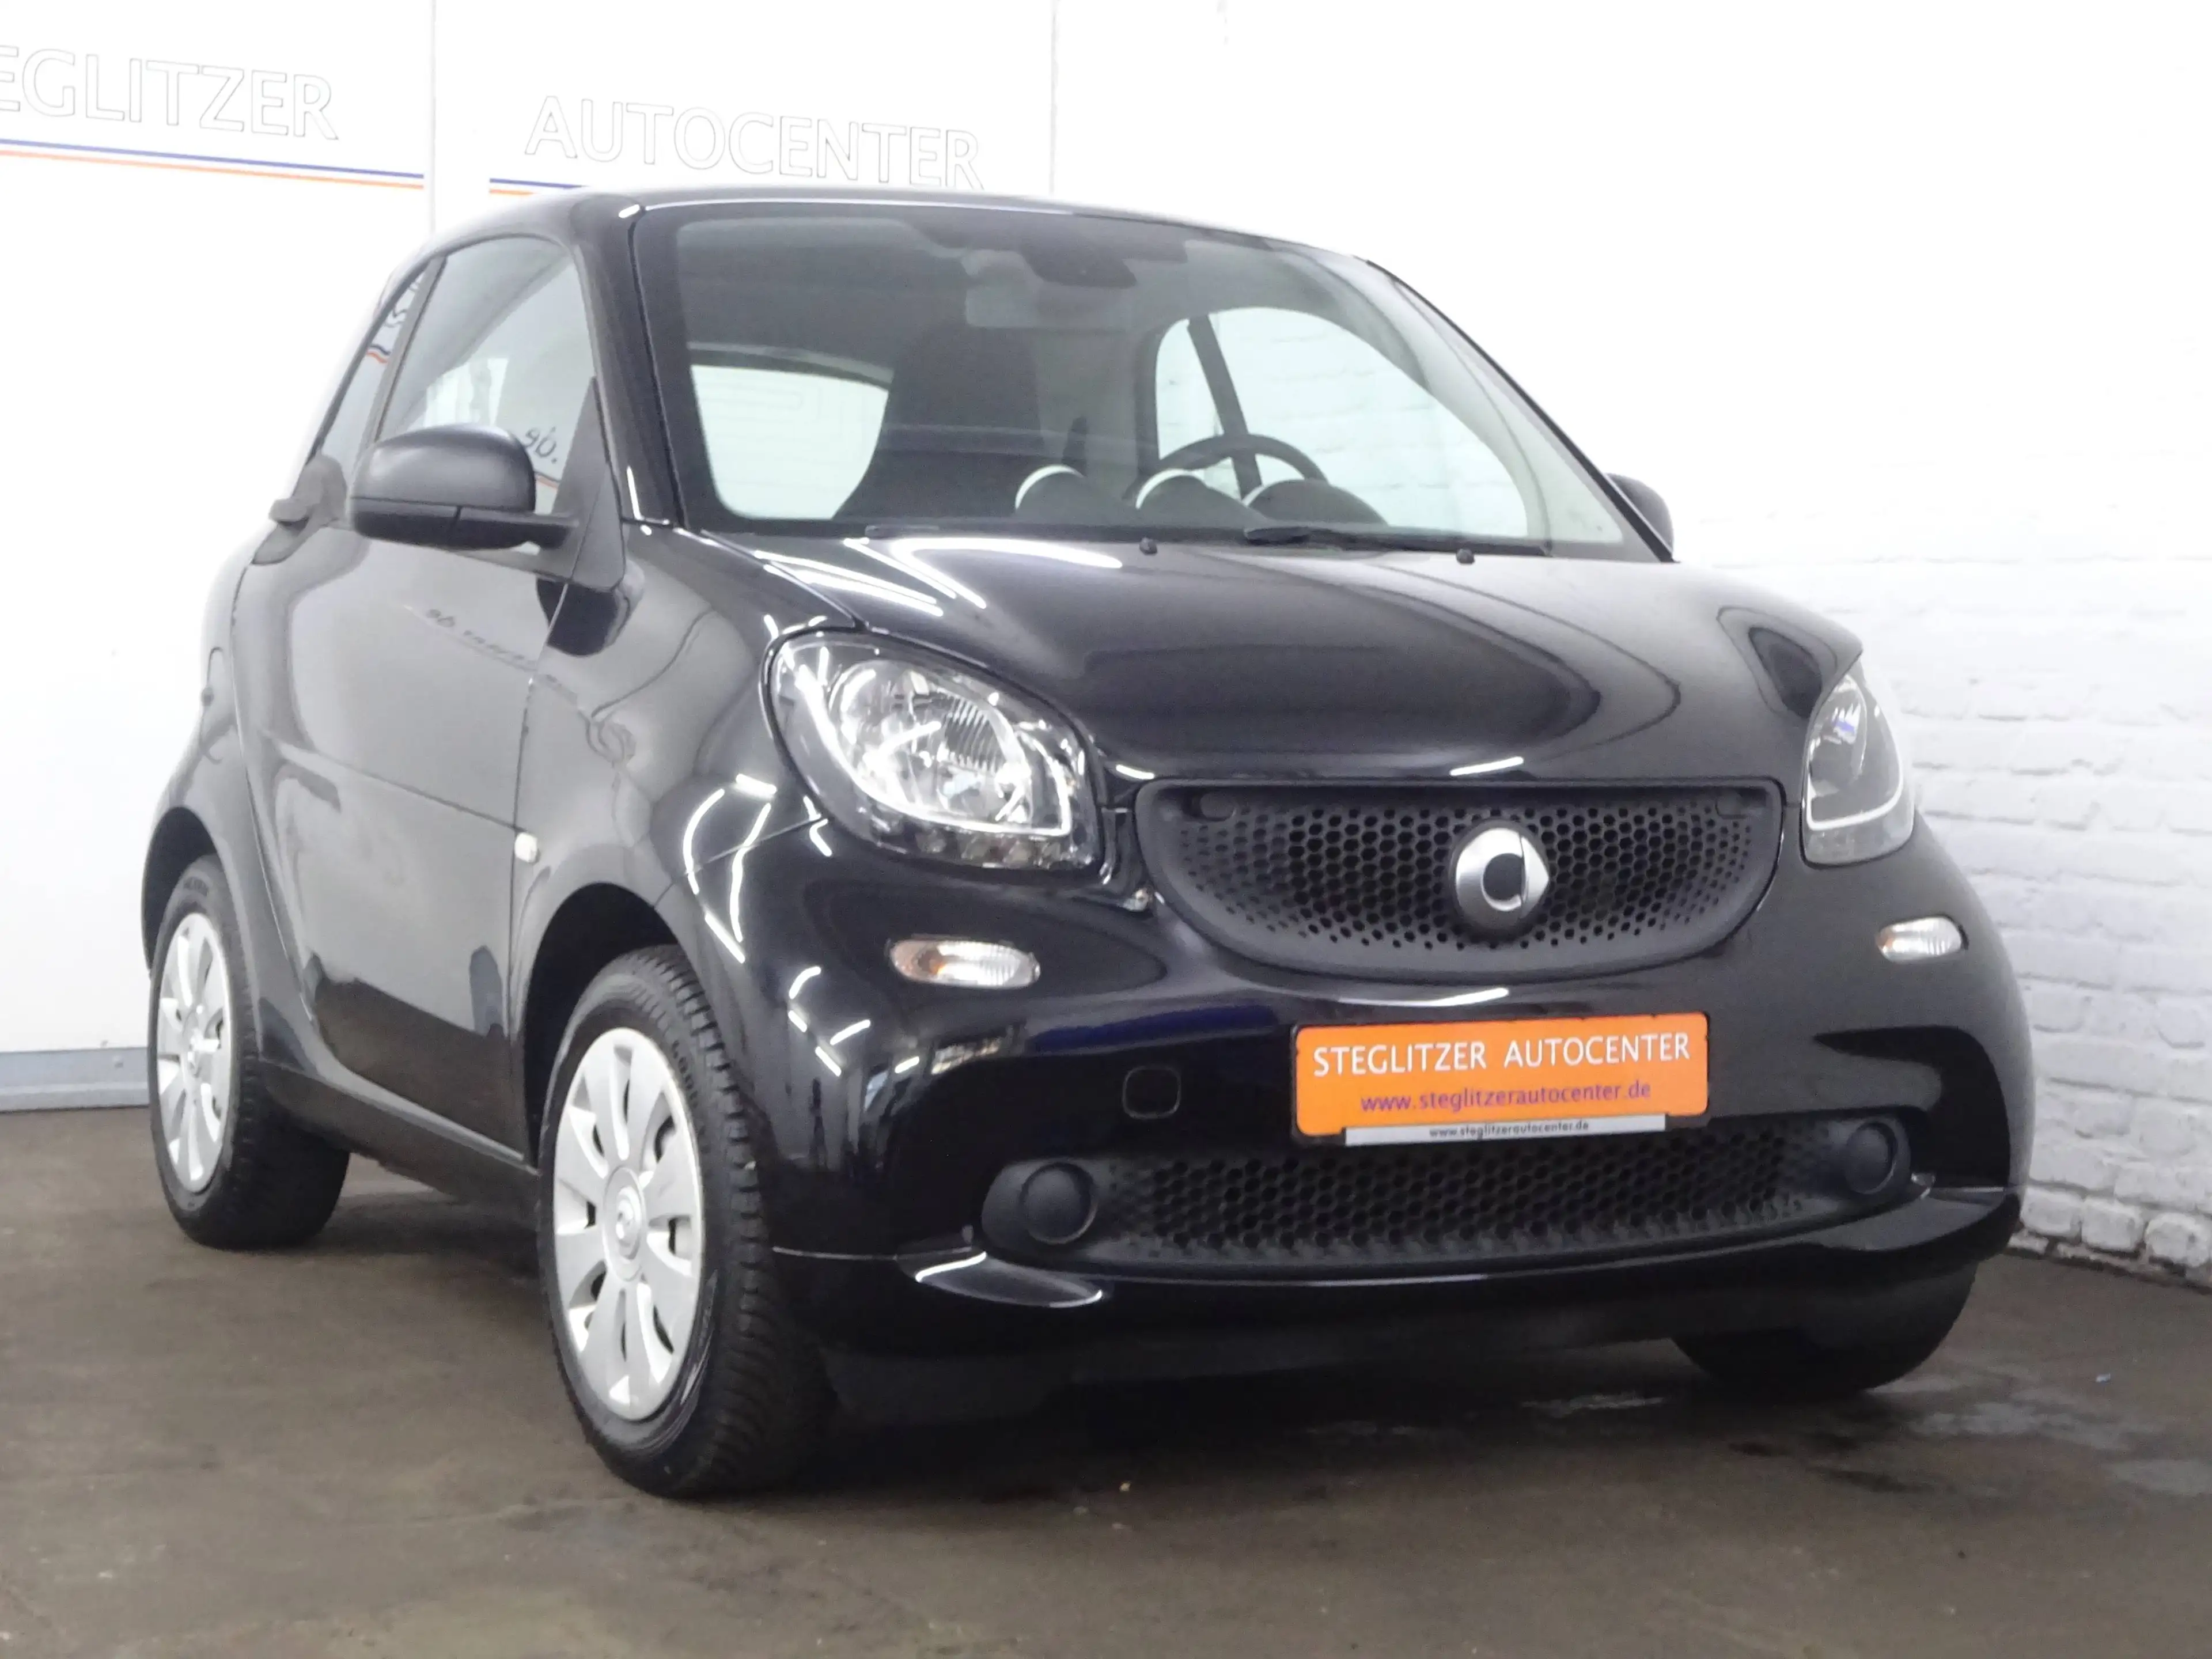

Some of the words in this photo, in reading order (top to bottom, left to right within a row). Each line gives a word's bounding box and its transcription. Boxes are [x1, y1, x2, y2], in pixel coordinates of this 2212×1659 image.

[525, 96, 985, 191] AUTOCENTER
[1313, 1041, 1487, 1077] STEGLITZER
[1503, 1032, 1690, 1069] AUTOCENTER
[1360, 1080, 1651, 1112] www.steglitzerautocenter.de
